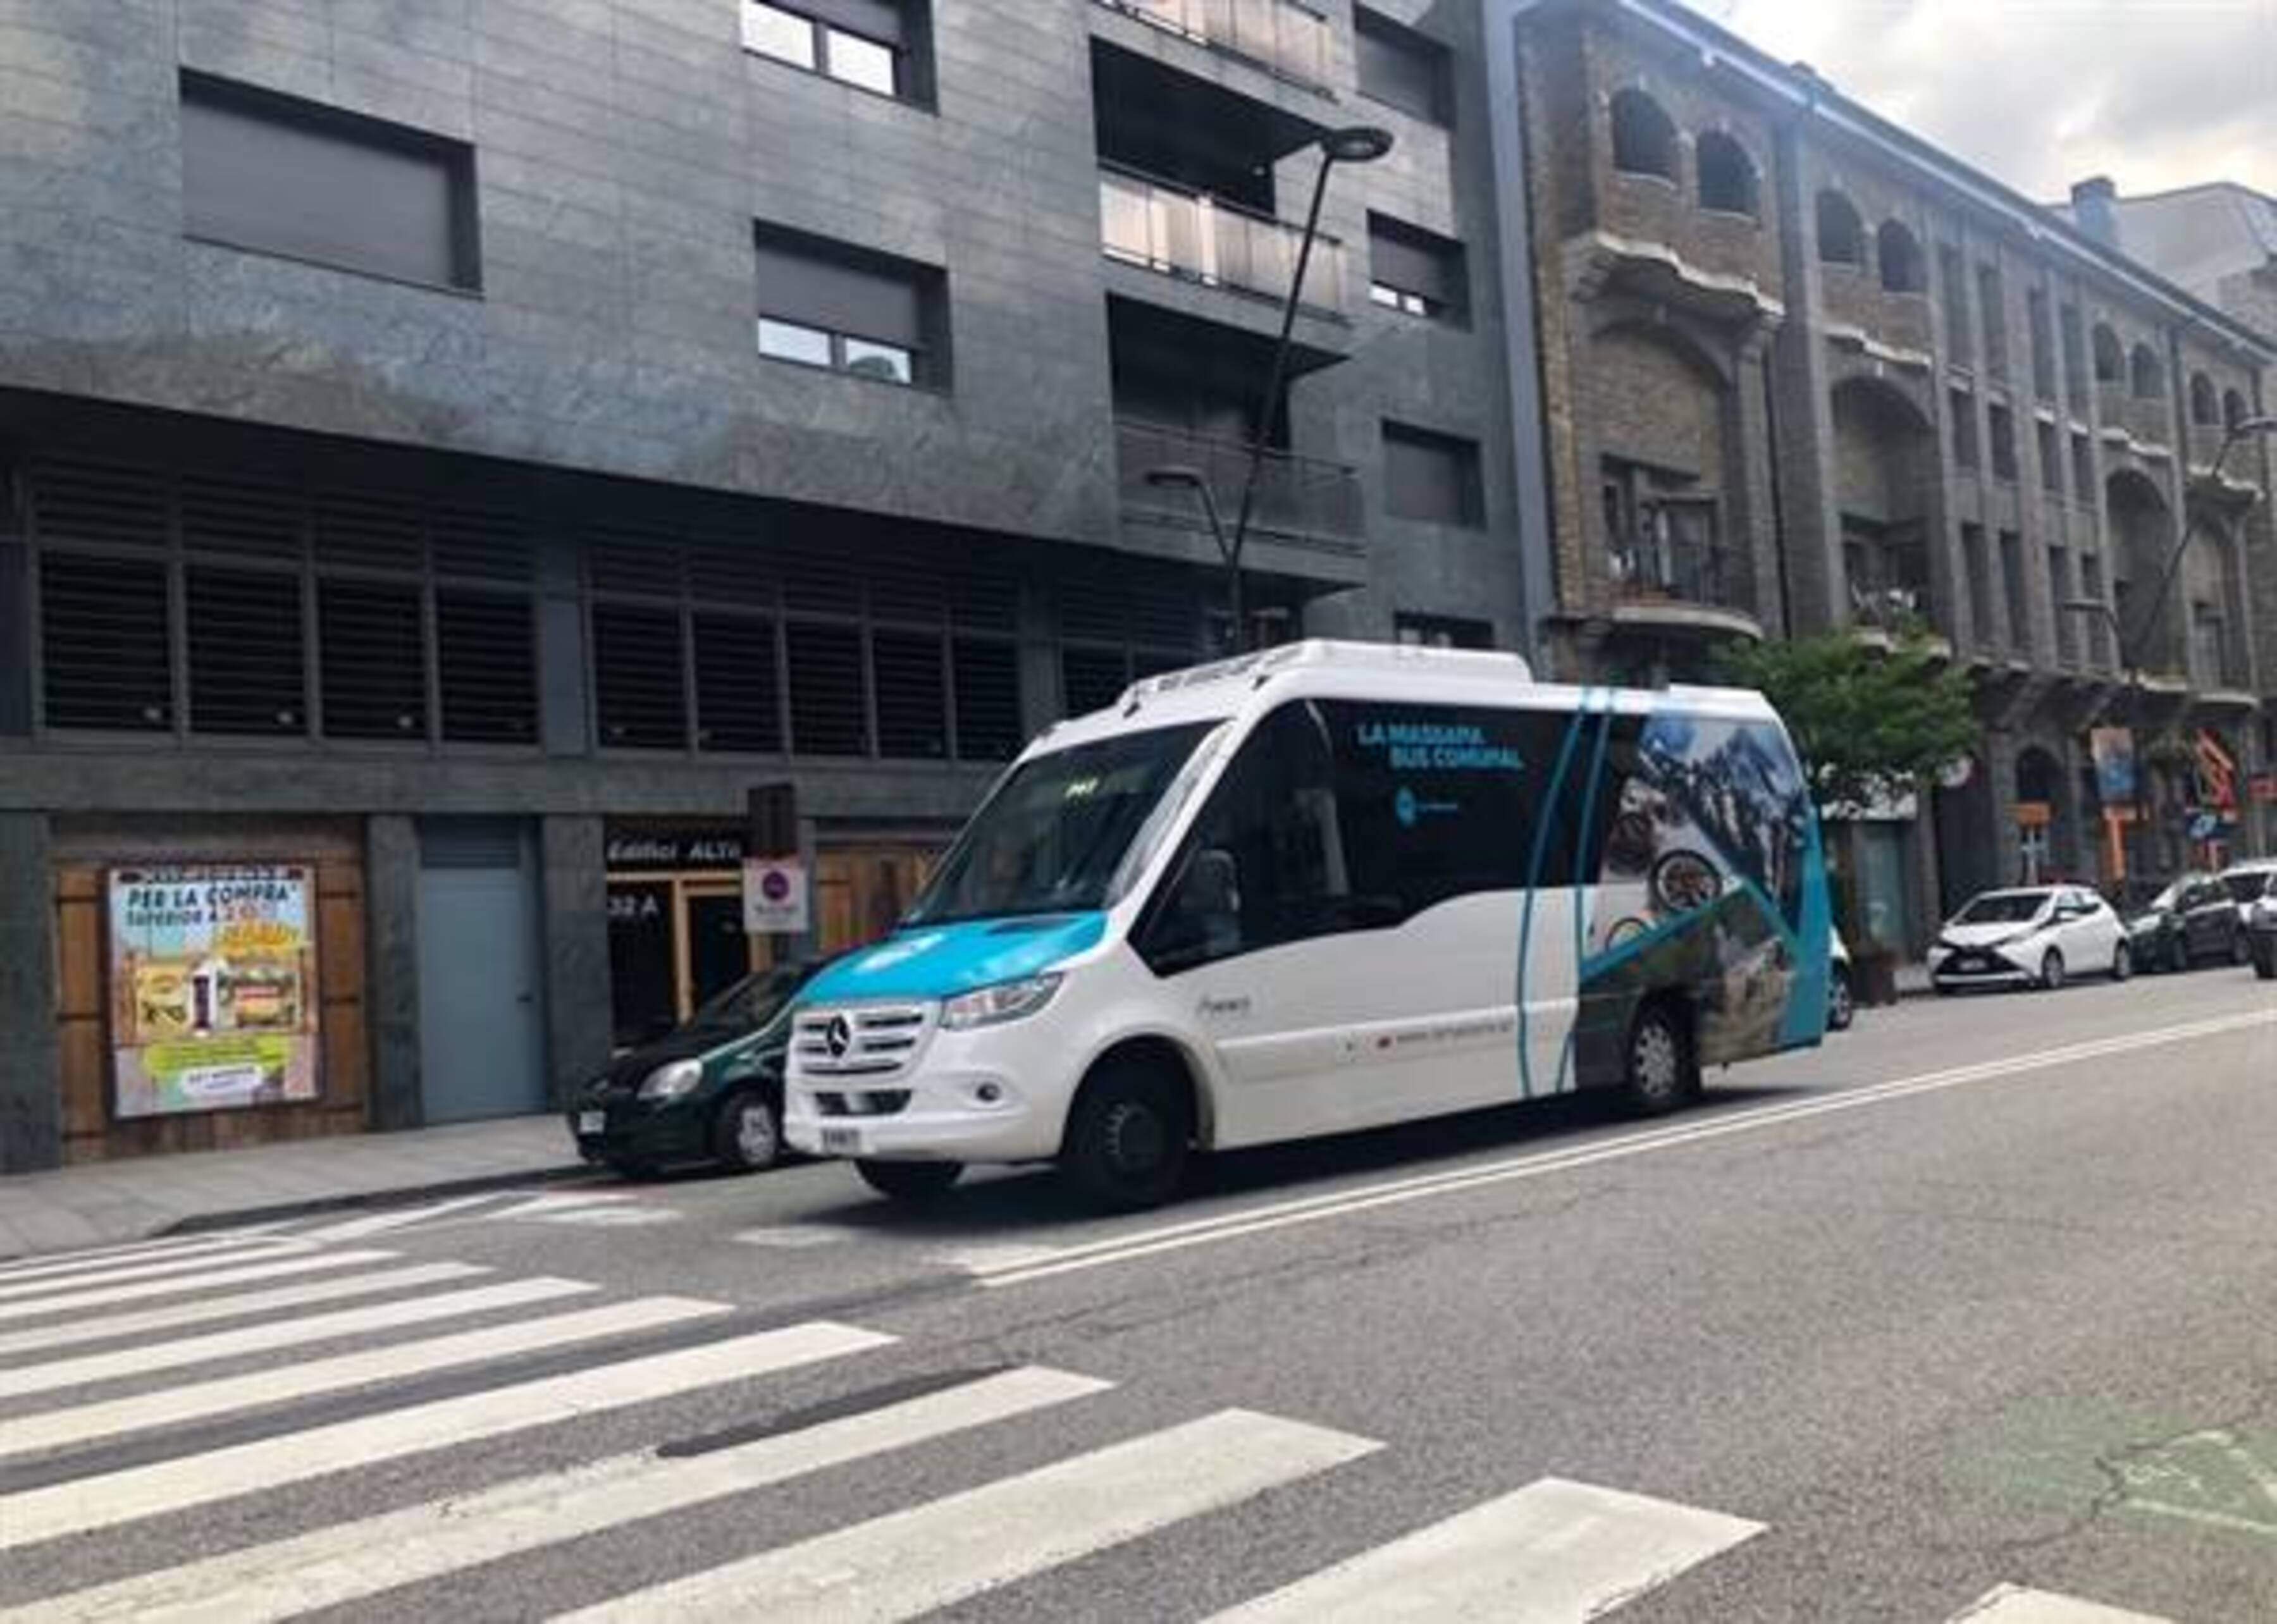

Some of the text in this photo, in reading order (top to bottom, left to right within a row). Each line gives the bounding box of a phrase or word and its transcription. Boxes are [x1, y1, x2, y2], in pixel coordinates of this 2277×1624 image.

[1358, 723, 1385, 744] LA
[1392, 746, 1428, 768] BUS
[128, 887, 165, 907] PER
[174, 887, 197, 907] LA
[641, 893, 660, 914] A
